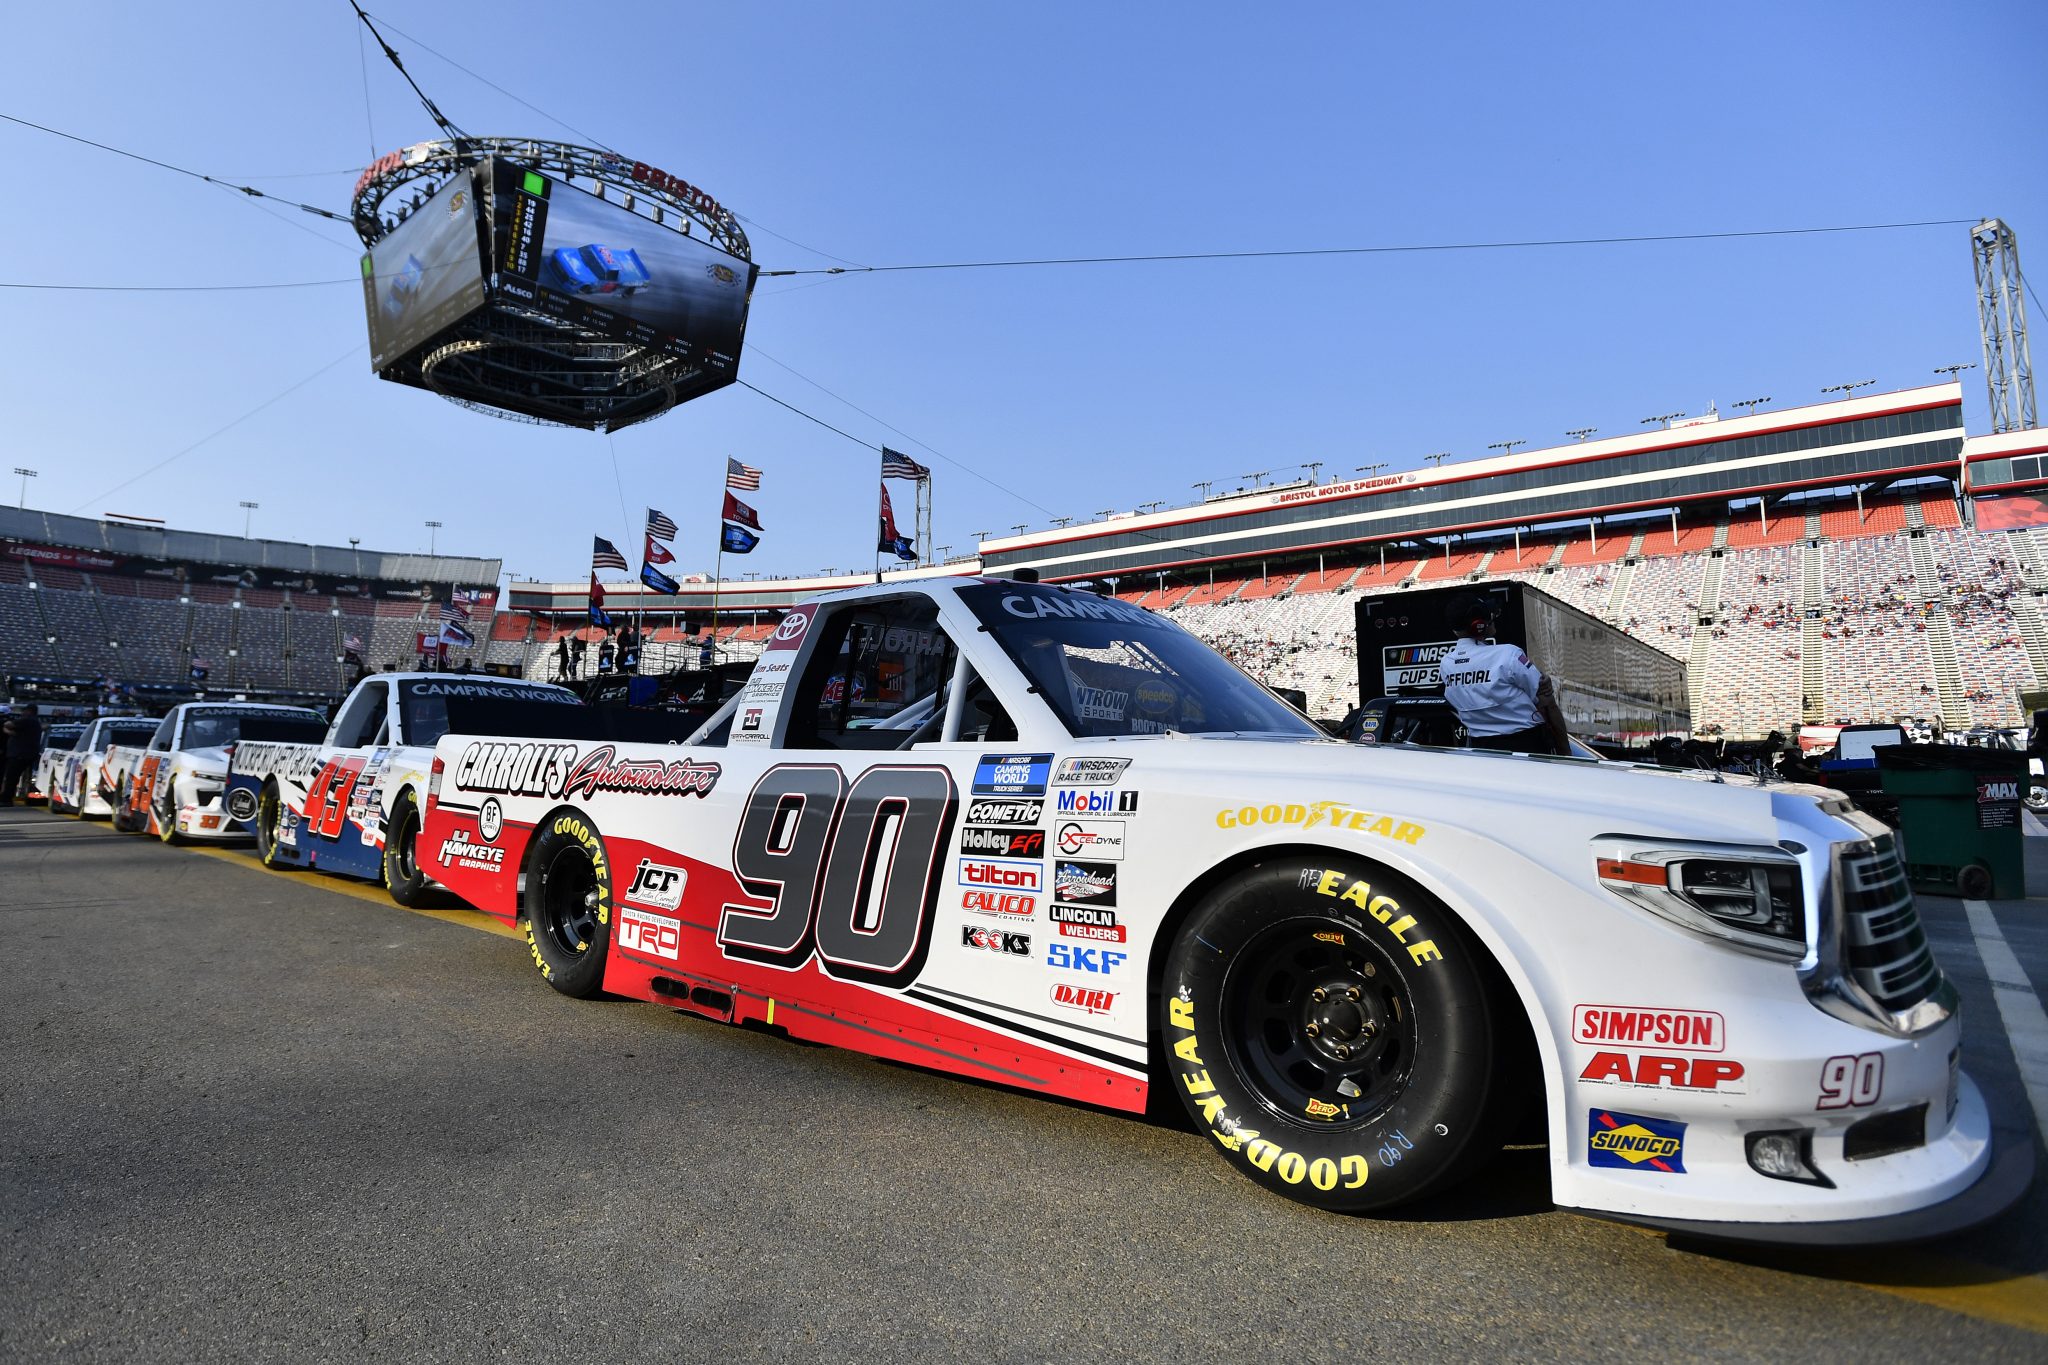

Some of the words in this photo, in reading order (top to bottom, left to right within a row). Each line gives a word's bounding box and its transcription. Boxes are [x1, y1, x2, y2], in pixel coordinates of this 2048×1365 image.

[631, 161, 721, 221] BRISTOL
[1279, 492, 1316, 503] BRISTOL
[1318, 485, 1351, 497] MOTOR
[1354, 475, 1404, 490] SPEEDWAY
[8, 546, 60, 560] LEGENDS
[1001, 595, 1161, 628] CAMPING
[766, 663, 789, 673] Seats
[1400, 669, 1427, 684] CUP
[1446, 669, 1491, 687] OFFICIAL
[412, 683, 514, 699] CAMPING
[513, 688, 581, 703] WORLD
[191, 708, 262, 718] CAMPING
[1131, 718, 1155, 733] BOOT
[456, 742, 578, 801] CARROLL'S
[564, 744, 722, 800] Automotive
[994, 765, 1031, 774] CAMPING
[1077, 760, 1119, 771] NASCAR
[993, 773, 1029, 784] WORLD
[1058, 773, 1083, 781] RACE
[1085, 772, 1115, 781] TRUCK
[302, 754, 369, 839] 43
[1057, 790, 1114, 811] Mobil
[486, 805, 497, 822] BF
[969, 803, 1042, 821] COMETIC
[1216, 800, 1426, 846] GOODYEAR
[437, 830, 505, 868] HAWKEYE
[962, 829, 1010, 855] Holley
[459, 858, 502, 873] GRAPHICS
[716, 762, 960, 990] 90
[964, 863, 1037, 887] tilton
[1055, 871, 1115, 886] Arrowhead
[1068, 883, 1095, 895] Brass
[658, 901, 675, 910] racing
[962, 890, 1036, 916] CALICO
[622, 909, 636, 917] TOYOTA
[636, 912, 651, 921] RACING
[651, 915, 679, 928] DEVELOPMENT
[998, 914, 1035, 923] COATINGS
[1051, 906, 1112, 926] LINCOLN
[1316, 868, 1444, 968] EAGLE
[621, 916, 678, 954] TRD
[962, 925, 1031, 957] KOOKS
[1065, 924, 1120, 941] WELDERS
[526, 919, 552, 979] EAGLE
[1047, 943, 1127, 975] SKF
[1054, 985, 1120, 1011] DART
[1582, 1009, 1713, 1047] SIMPSON
[1579, 1051, 1745, 1089] ARP
[1815, 1051, 1884, 1110] 90
[1169, 996, 1370, 1192] GOODYEAR
[1310, 1102, 1334, 1114] AERO
[1592, 1130, 1679, 1155] SUNOCO
